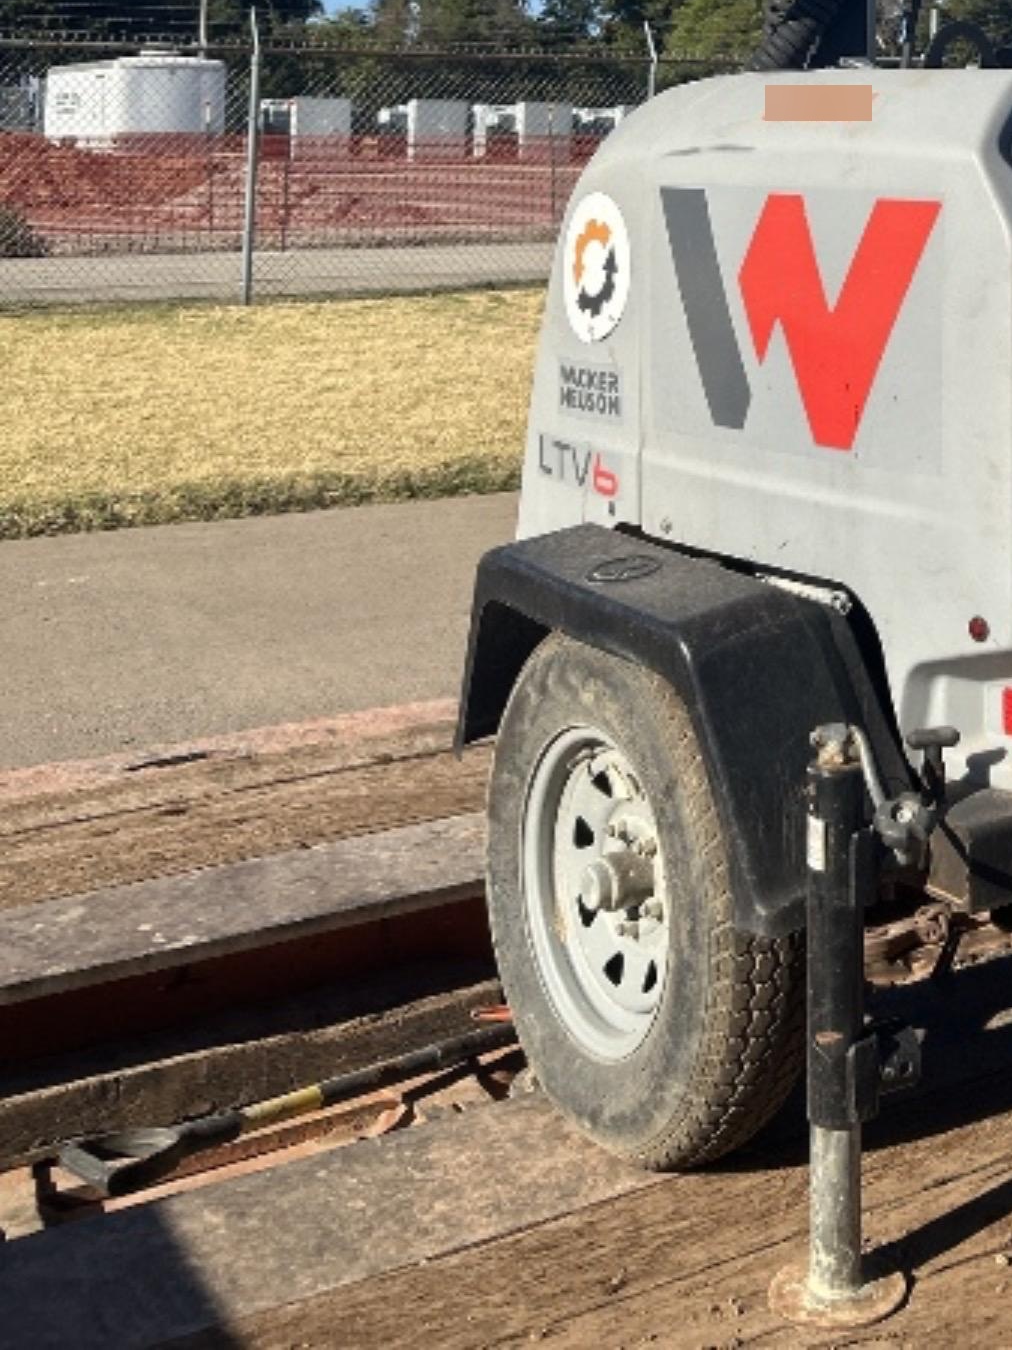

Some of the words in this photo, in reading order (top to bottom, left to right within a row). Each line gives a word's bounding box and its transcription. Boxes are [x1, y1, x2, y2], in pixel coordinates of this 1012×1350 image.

[560, 365, 619, 393] WACKER
[560, 386, 621, 416] NEUSON
[539, 434, 619, 497] LTV6
